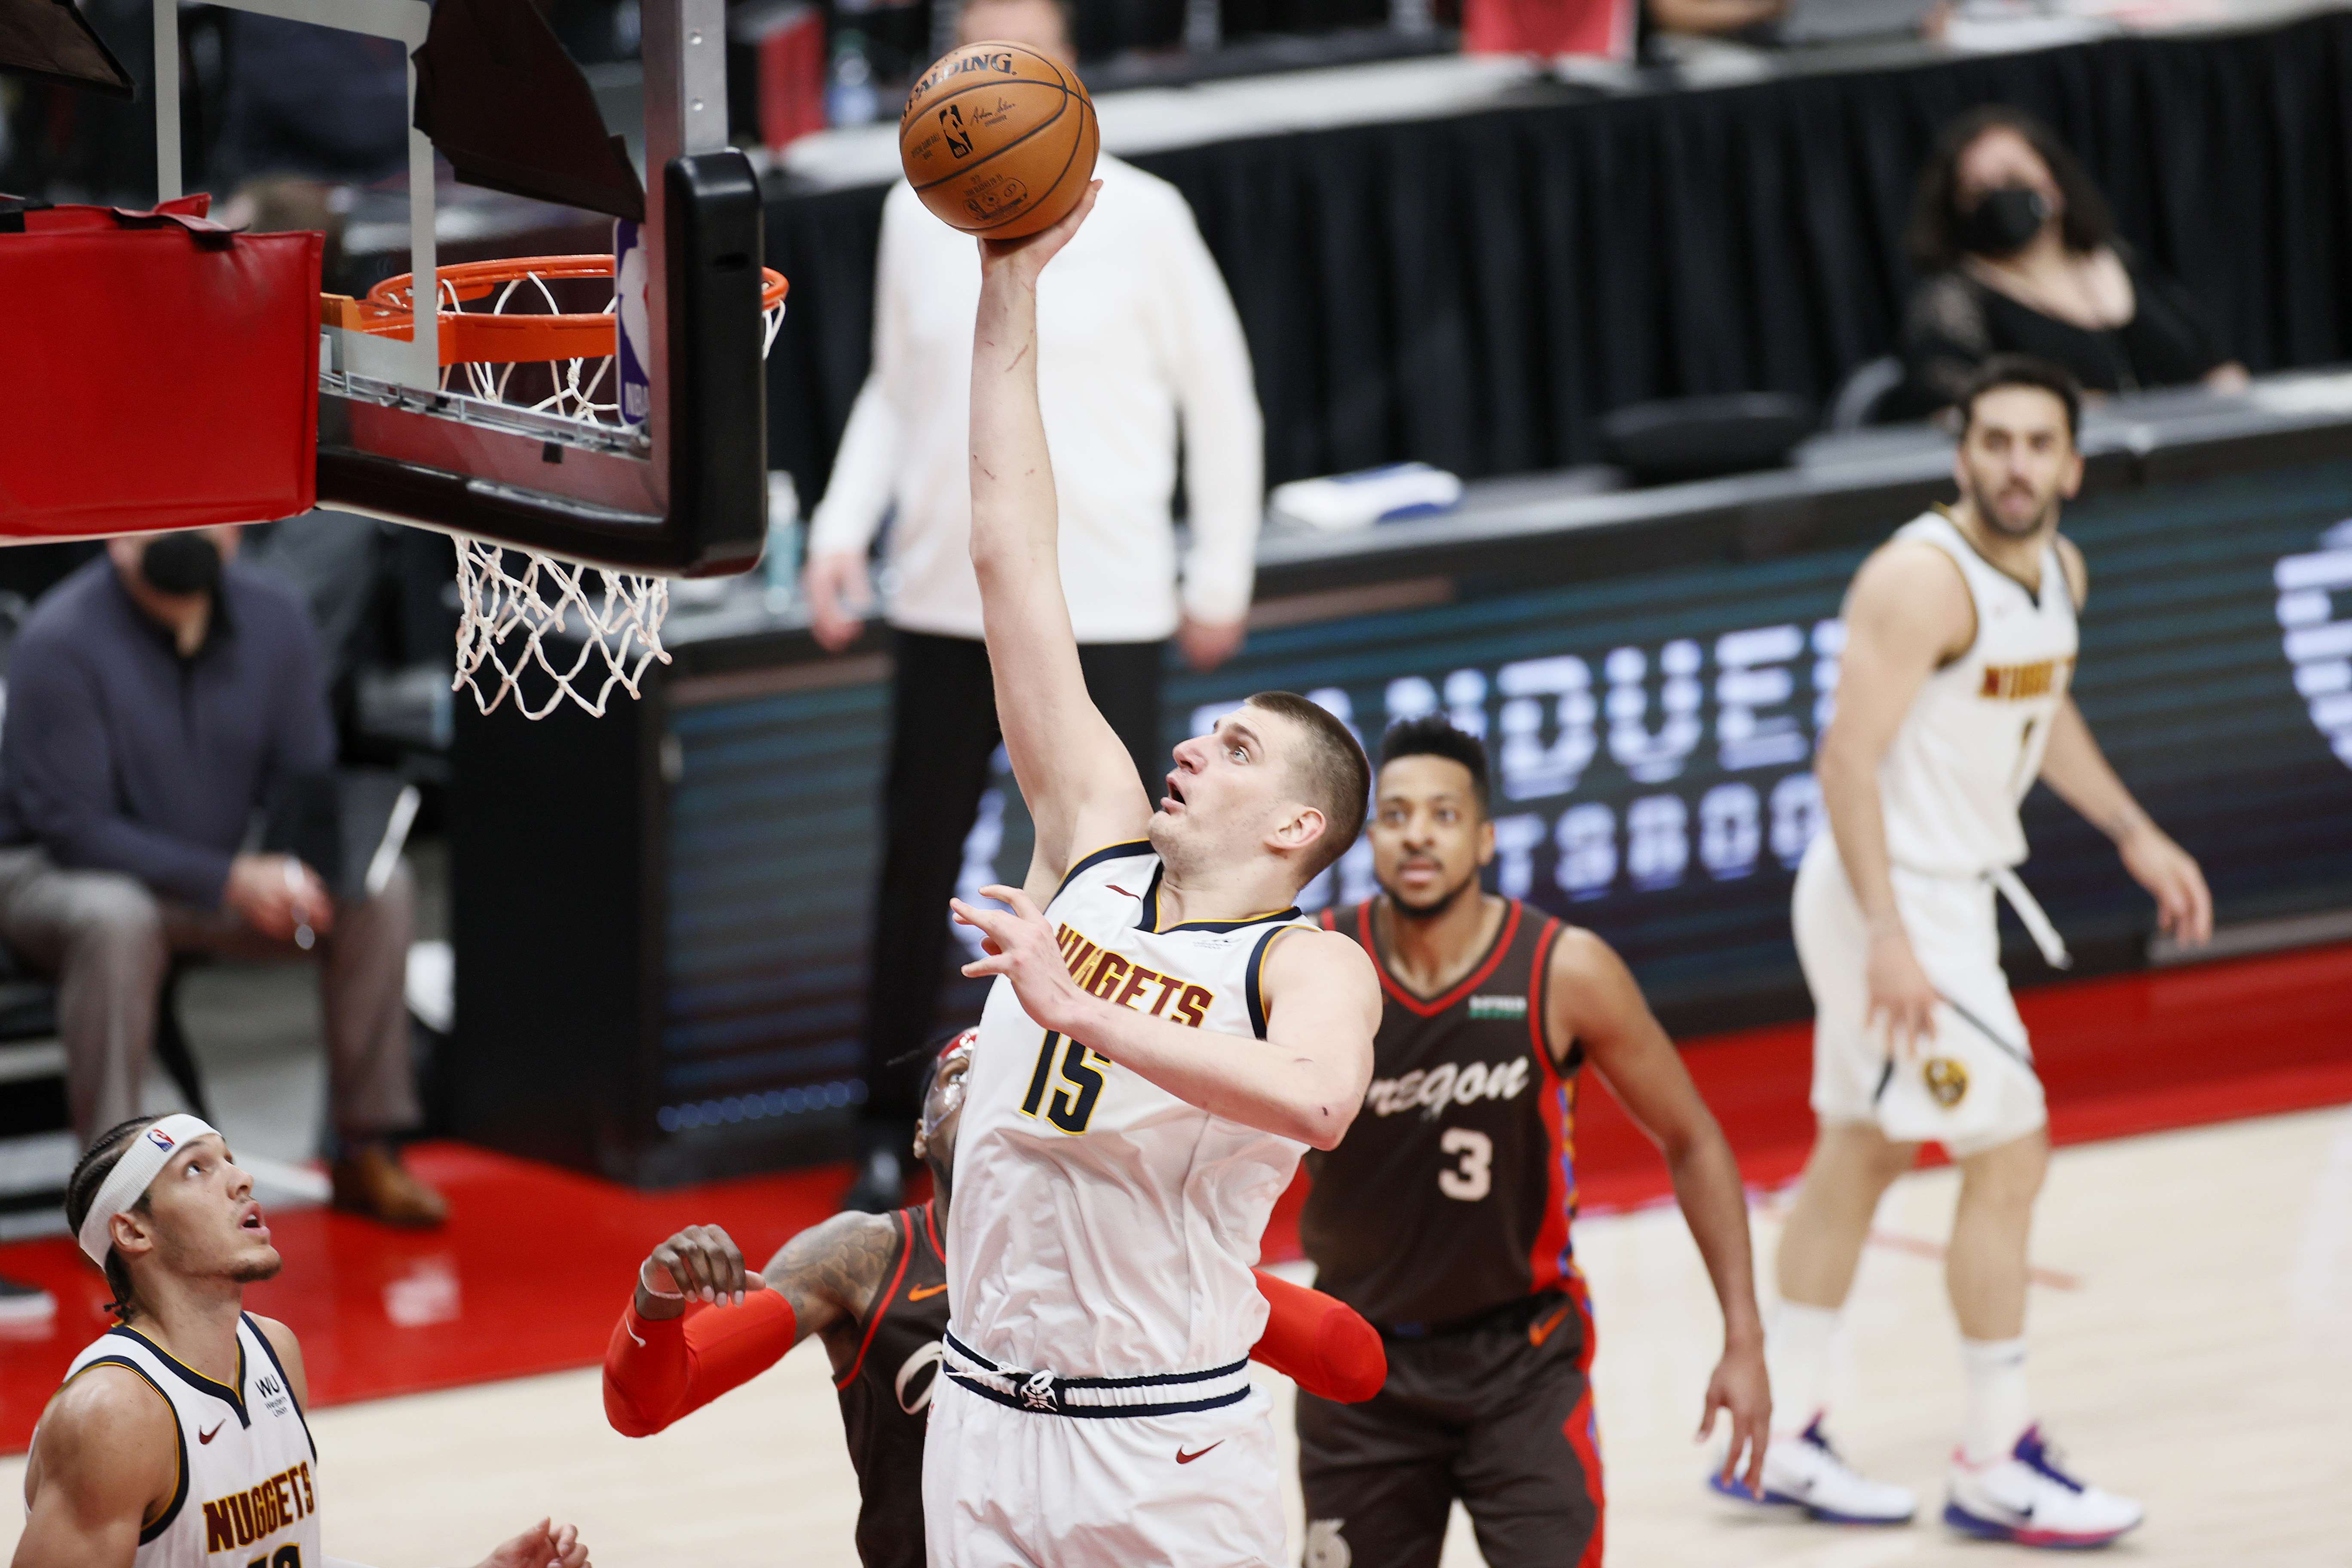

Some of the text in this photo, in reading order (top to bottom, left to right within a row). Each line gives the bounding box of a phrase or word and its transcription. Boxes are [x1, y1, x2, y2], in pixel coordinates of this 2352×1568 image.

[903, 53, 1012, 118] ALDING
[1019, 1029, 1112, 1135] 15
[1366, 1056, 1530, 1121] regon
[1438, 1126, 1493, 1202] 3
[254, 1373, 280, 1399] WU
[202, 1460, 315, 1555] NUGGETS
